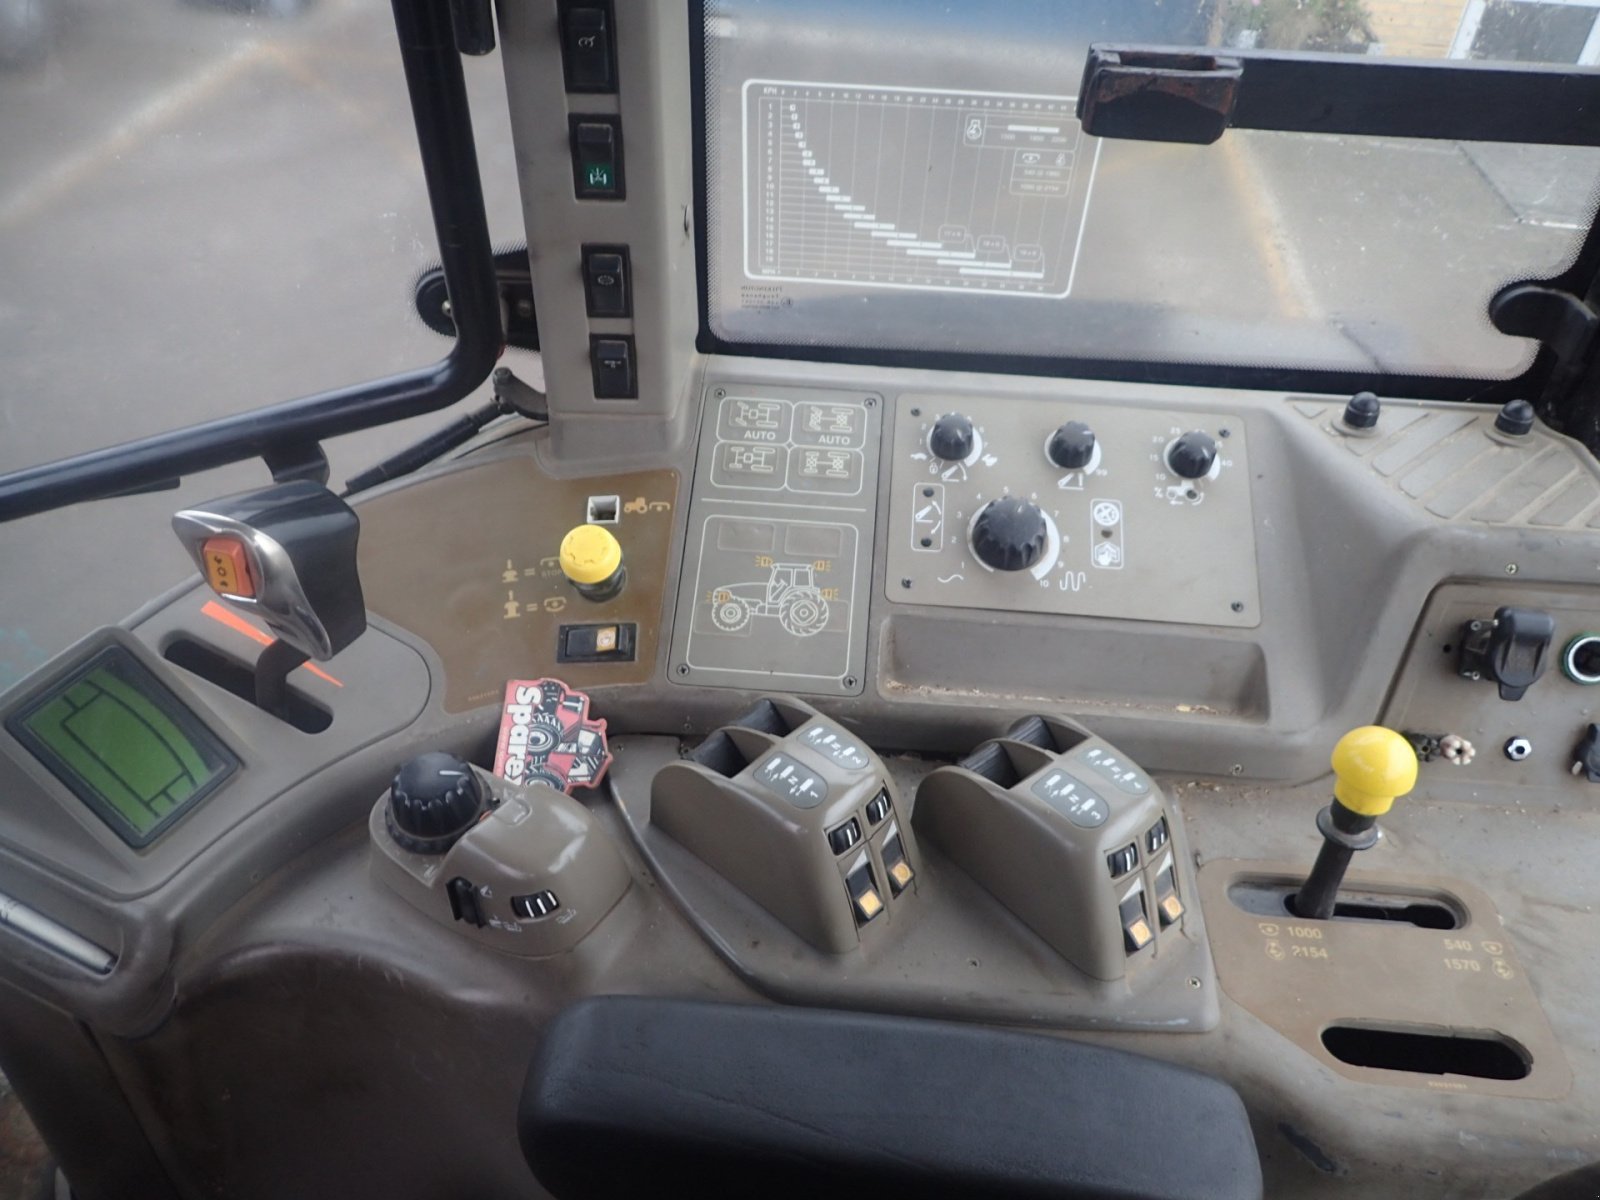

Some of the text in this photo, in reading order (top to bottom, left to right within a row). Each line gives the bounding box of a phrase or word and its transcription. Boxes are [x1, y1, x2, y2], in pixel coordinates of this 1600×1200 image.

[764, 87, 778, 95] KPH
[744, 430, 776, 440] AUTO
[818, 434, 850, 445] AUTO
[1040, 580, 1049, 588] 10
[1288, 926, 1323, 939] 1000
[1443, 938, 1473, 952] 540
[1292, 945, 1328, 958] 2154
[1443, 958, 1480, 971] 1570
